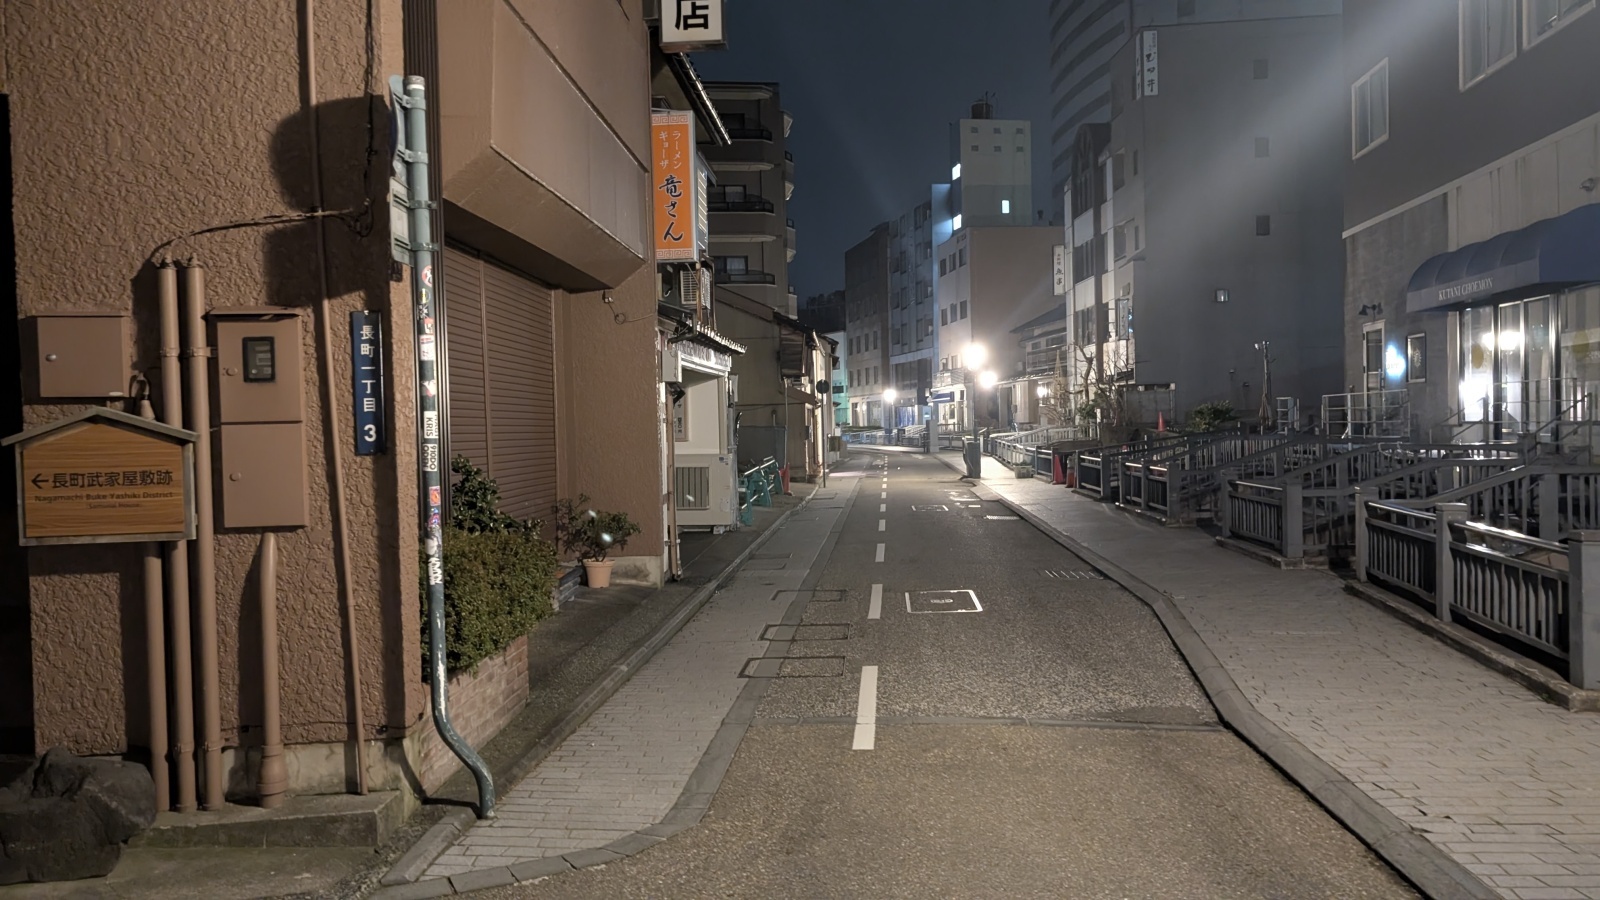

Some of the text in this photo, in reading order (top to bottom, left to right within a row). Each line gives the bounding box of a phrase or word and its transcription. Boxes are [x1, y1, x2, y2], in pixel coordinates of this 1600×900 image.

[675, 0, 709, 30] 店
[659, 131, 669, 170] ギョーザ
[672, 130, 682, 170] ラーメン
[658, 174, 684, 242] 竜さん
[1438, 278, 1494, 301] KUTANI CHOEMON
[360, 325, 377, 442] 長町一丁目 3
[425, 417, 434, 437] KRIS
[52, 470, 173, 488] 長町武家屋敷跡
[34, 490, 173, 504] Nagamachi Buke Yashiki District
